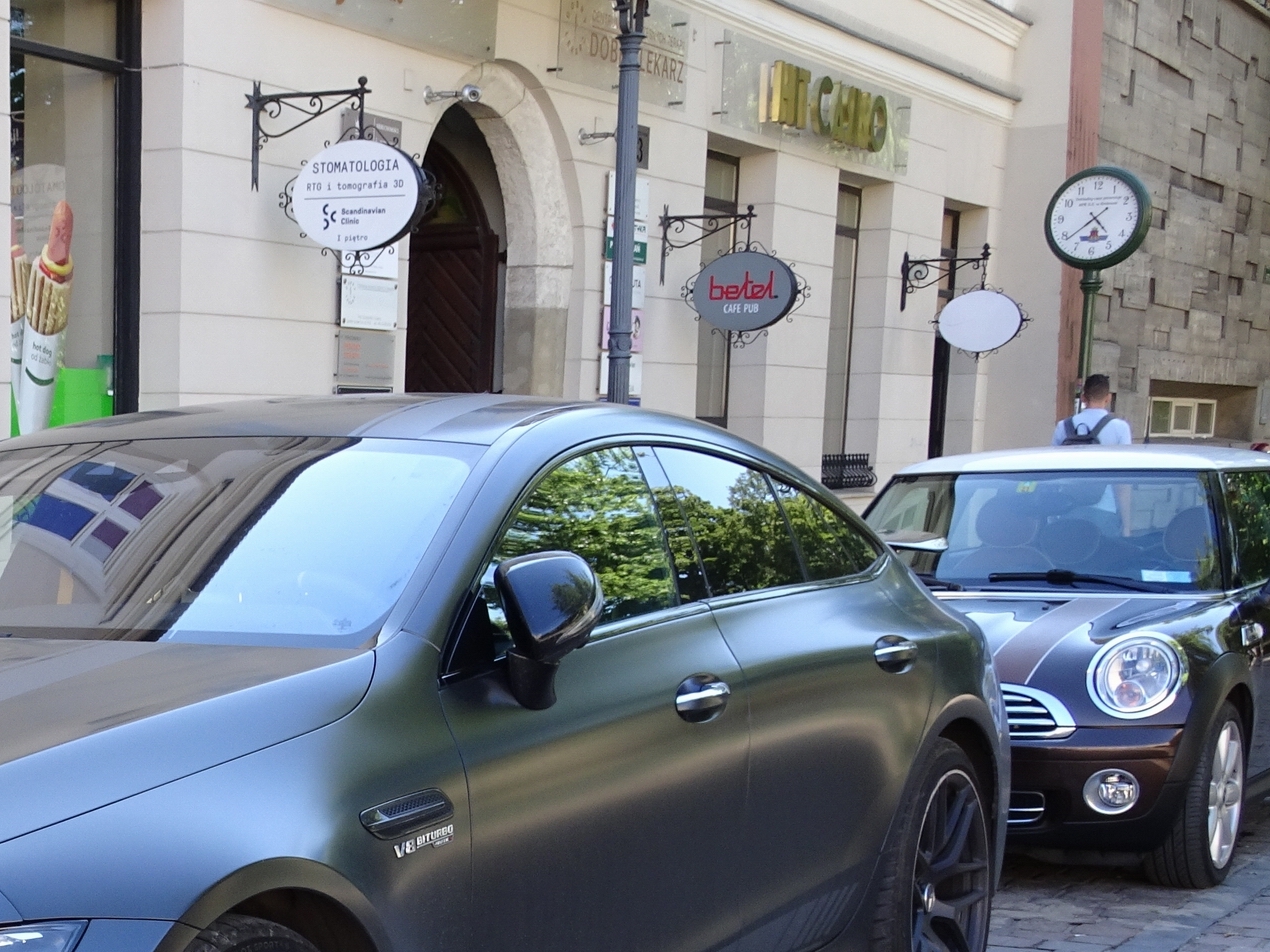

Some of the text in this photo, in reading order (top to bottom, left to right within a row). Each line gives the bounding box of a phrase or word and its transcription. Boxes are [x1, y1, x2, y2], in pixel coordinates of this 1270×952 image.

[312, 159, 399, 174] STOMATOLOGIA
[306, 179, 404, 192] RTG i tomografia 3D
[1094, 181, 1103, 190] 12
[1113, 185, 1116, 194] 1
[1078, 187, 1085, 196] 11
[1064, 199, 1074, 208] 10
[1123, 196, 1130, 206] 2
[341, 207, 386, 216] Scandinavian
[341, 217, 360, 225] Clinic
[1057, 215, 1065, 224] 9
[1125, 212, 1133, 222] 3
[1061, 231, 1069, 241] 8
[1118, 229, 1125, 238] 4
[1074, 242, 1080, 251] 7
[1105, 241, 1112, 250] 5
[1088, 247, 1095, 256] 6
[723, 303, 759, 314] CAFE PUB
[32, 341, 42, 353] hot
[42, 346, 52, 358] dog
[393, 838, 417, 859] V8
[416, 824, 453, 846] BITURBO
